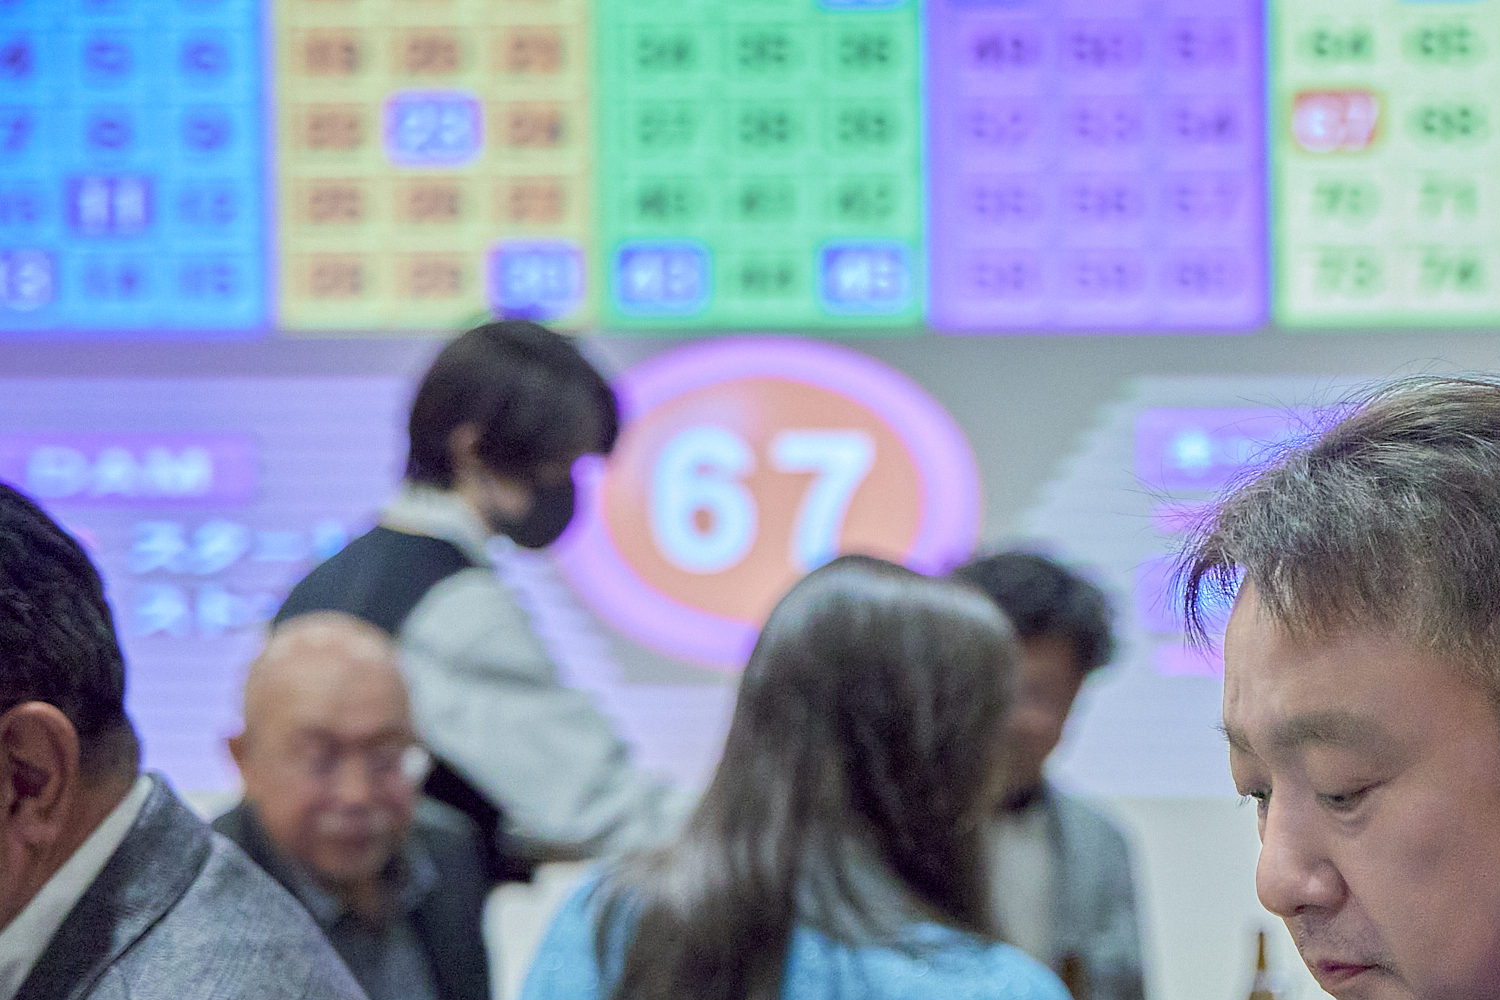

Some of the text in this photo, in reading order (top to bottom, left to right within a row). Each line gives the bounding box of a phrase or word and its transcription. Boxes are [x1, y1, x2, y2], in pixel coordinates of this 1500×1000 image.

[1303, 20, 1376, 68] 64
[1406, 18, 1482, 66] 65
[1296, 98, 1374, 149] 67
[1409, 97, 1484, 145] 68
[78, 178, 147, 230] 11
[1306, 176, 1376, 224] 70
[1411, 175, 1478, 222] 71
[1306, 248, 1380, 297] 73
[1412, 248, 1484, 294] 74
[27, 446, 212, 497] DAM
[652, 424, 876, 575] 67
